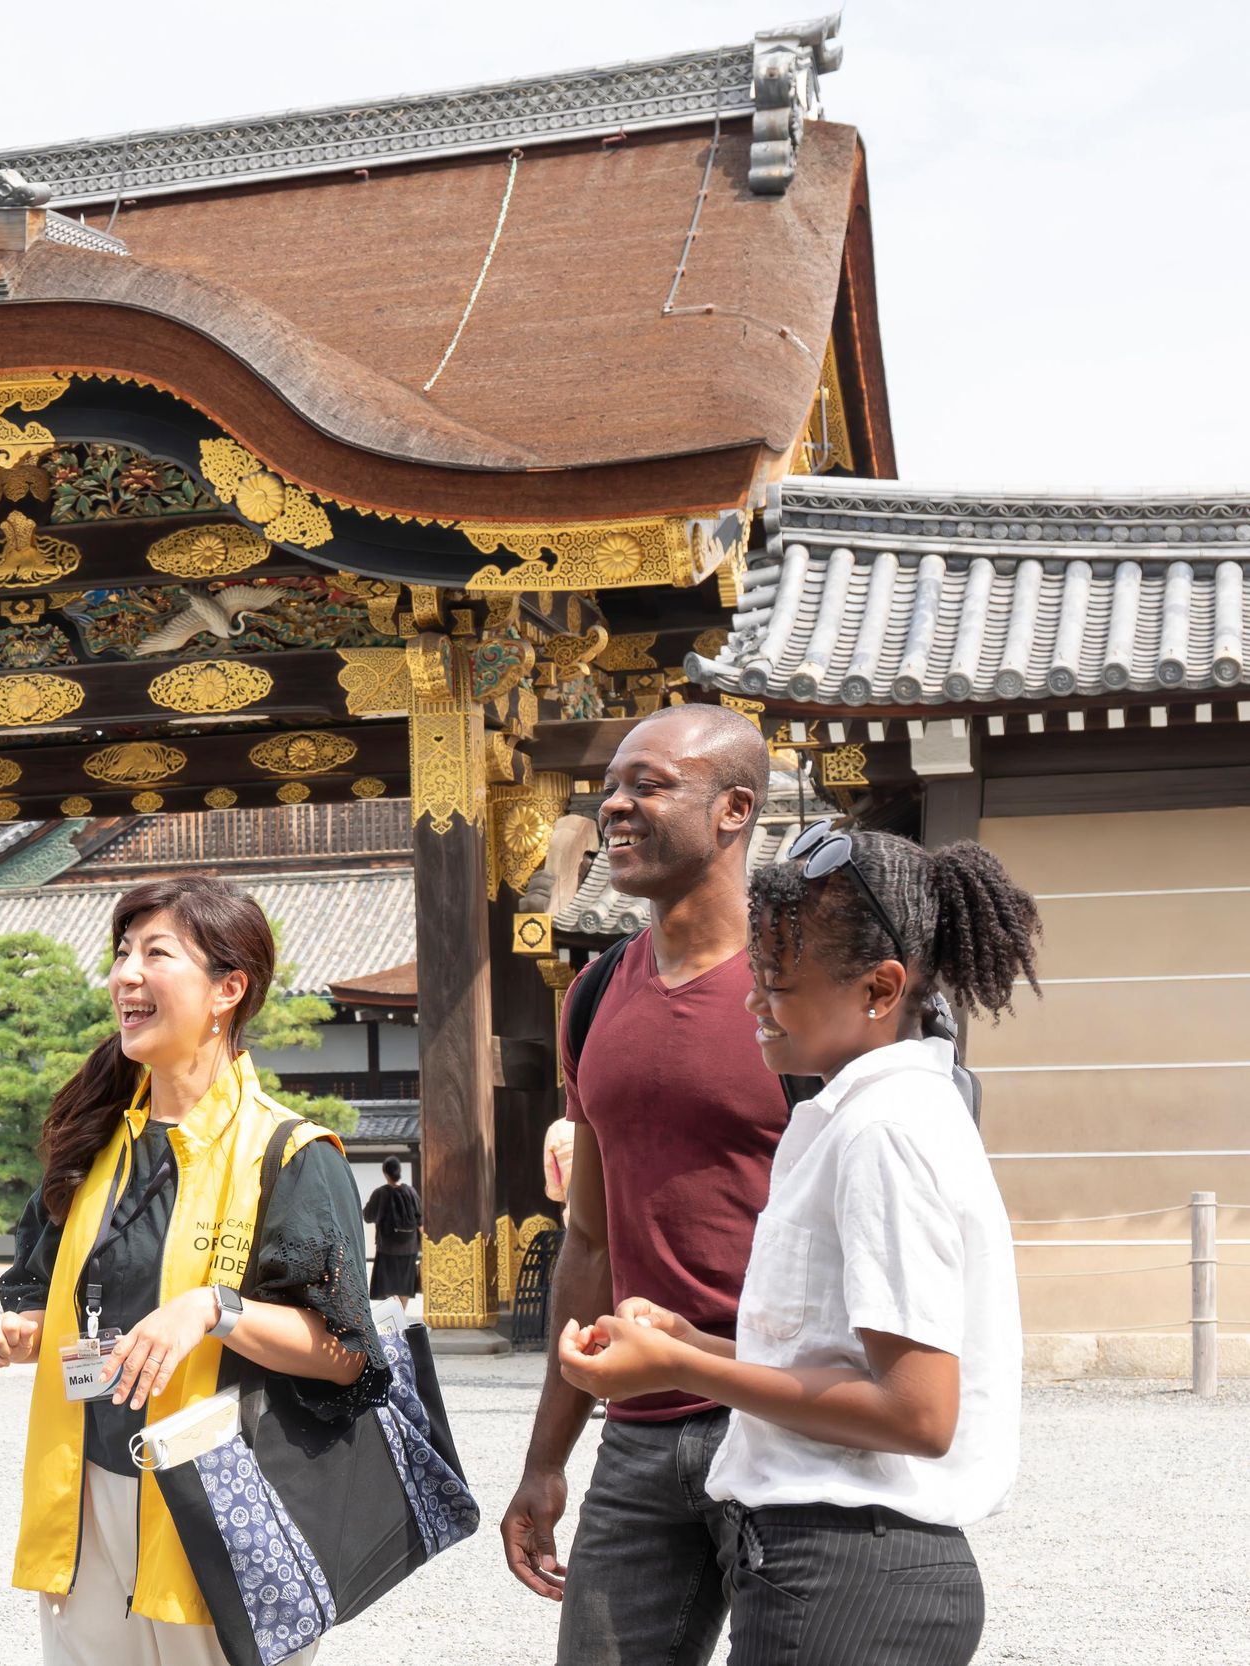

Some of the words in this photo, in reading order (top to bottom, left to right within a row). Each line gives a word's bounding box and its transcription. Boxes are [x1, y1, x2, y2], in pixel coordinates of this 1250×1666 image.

[226, 1218, 253, 1232] CAST
[194, 1234, 251, 1252] OFCIA
[210, 1255, 247, 1275] IDE
[69, 1373, 94, 1386] Maki
